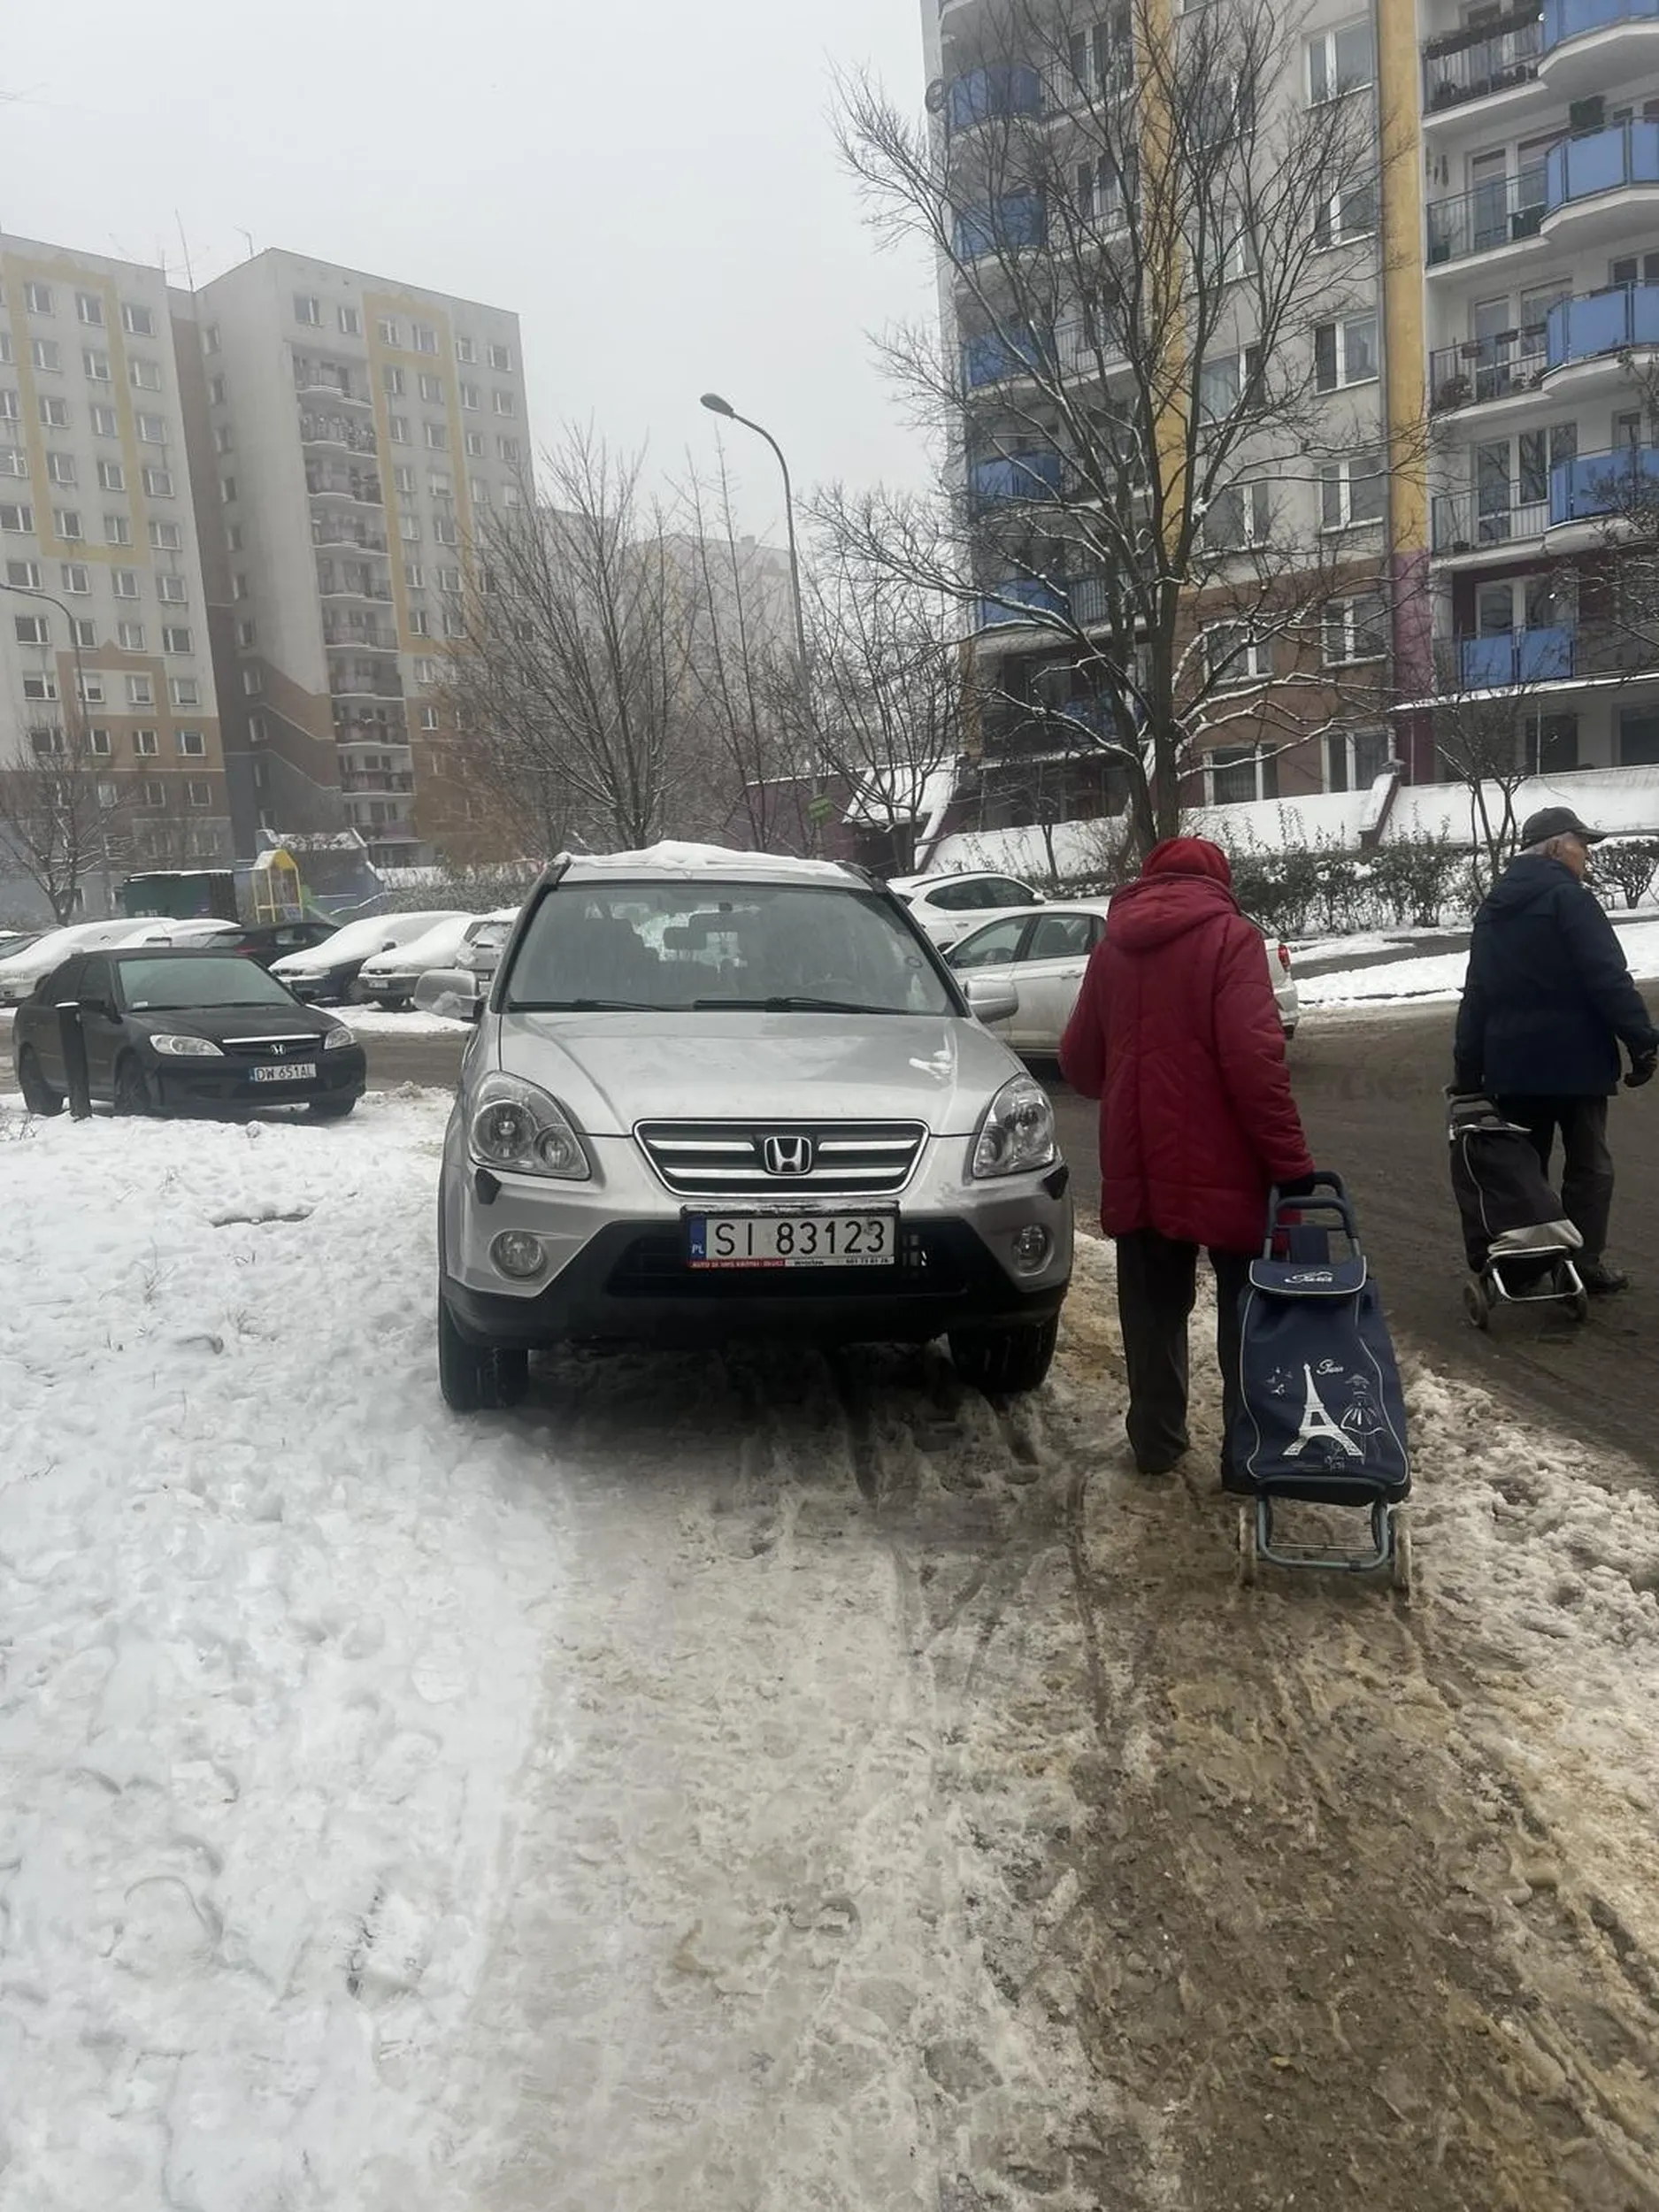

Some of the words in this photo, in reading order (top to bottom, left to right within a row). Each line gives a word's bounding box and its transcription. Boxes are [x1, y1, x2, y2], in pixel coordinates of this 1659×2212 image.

[257, 1068, 274, 1080] DW
[715, 1222, 753, 1256] SI
[775, 1220, 886, 1256] 83123
[691, 1244, 705, 1255] PL
